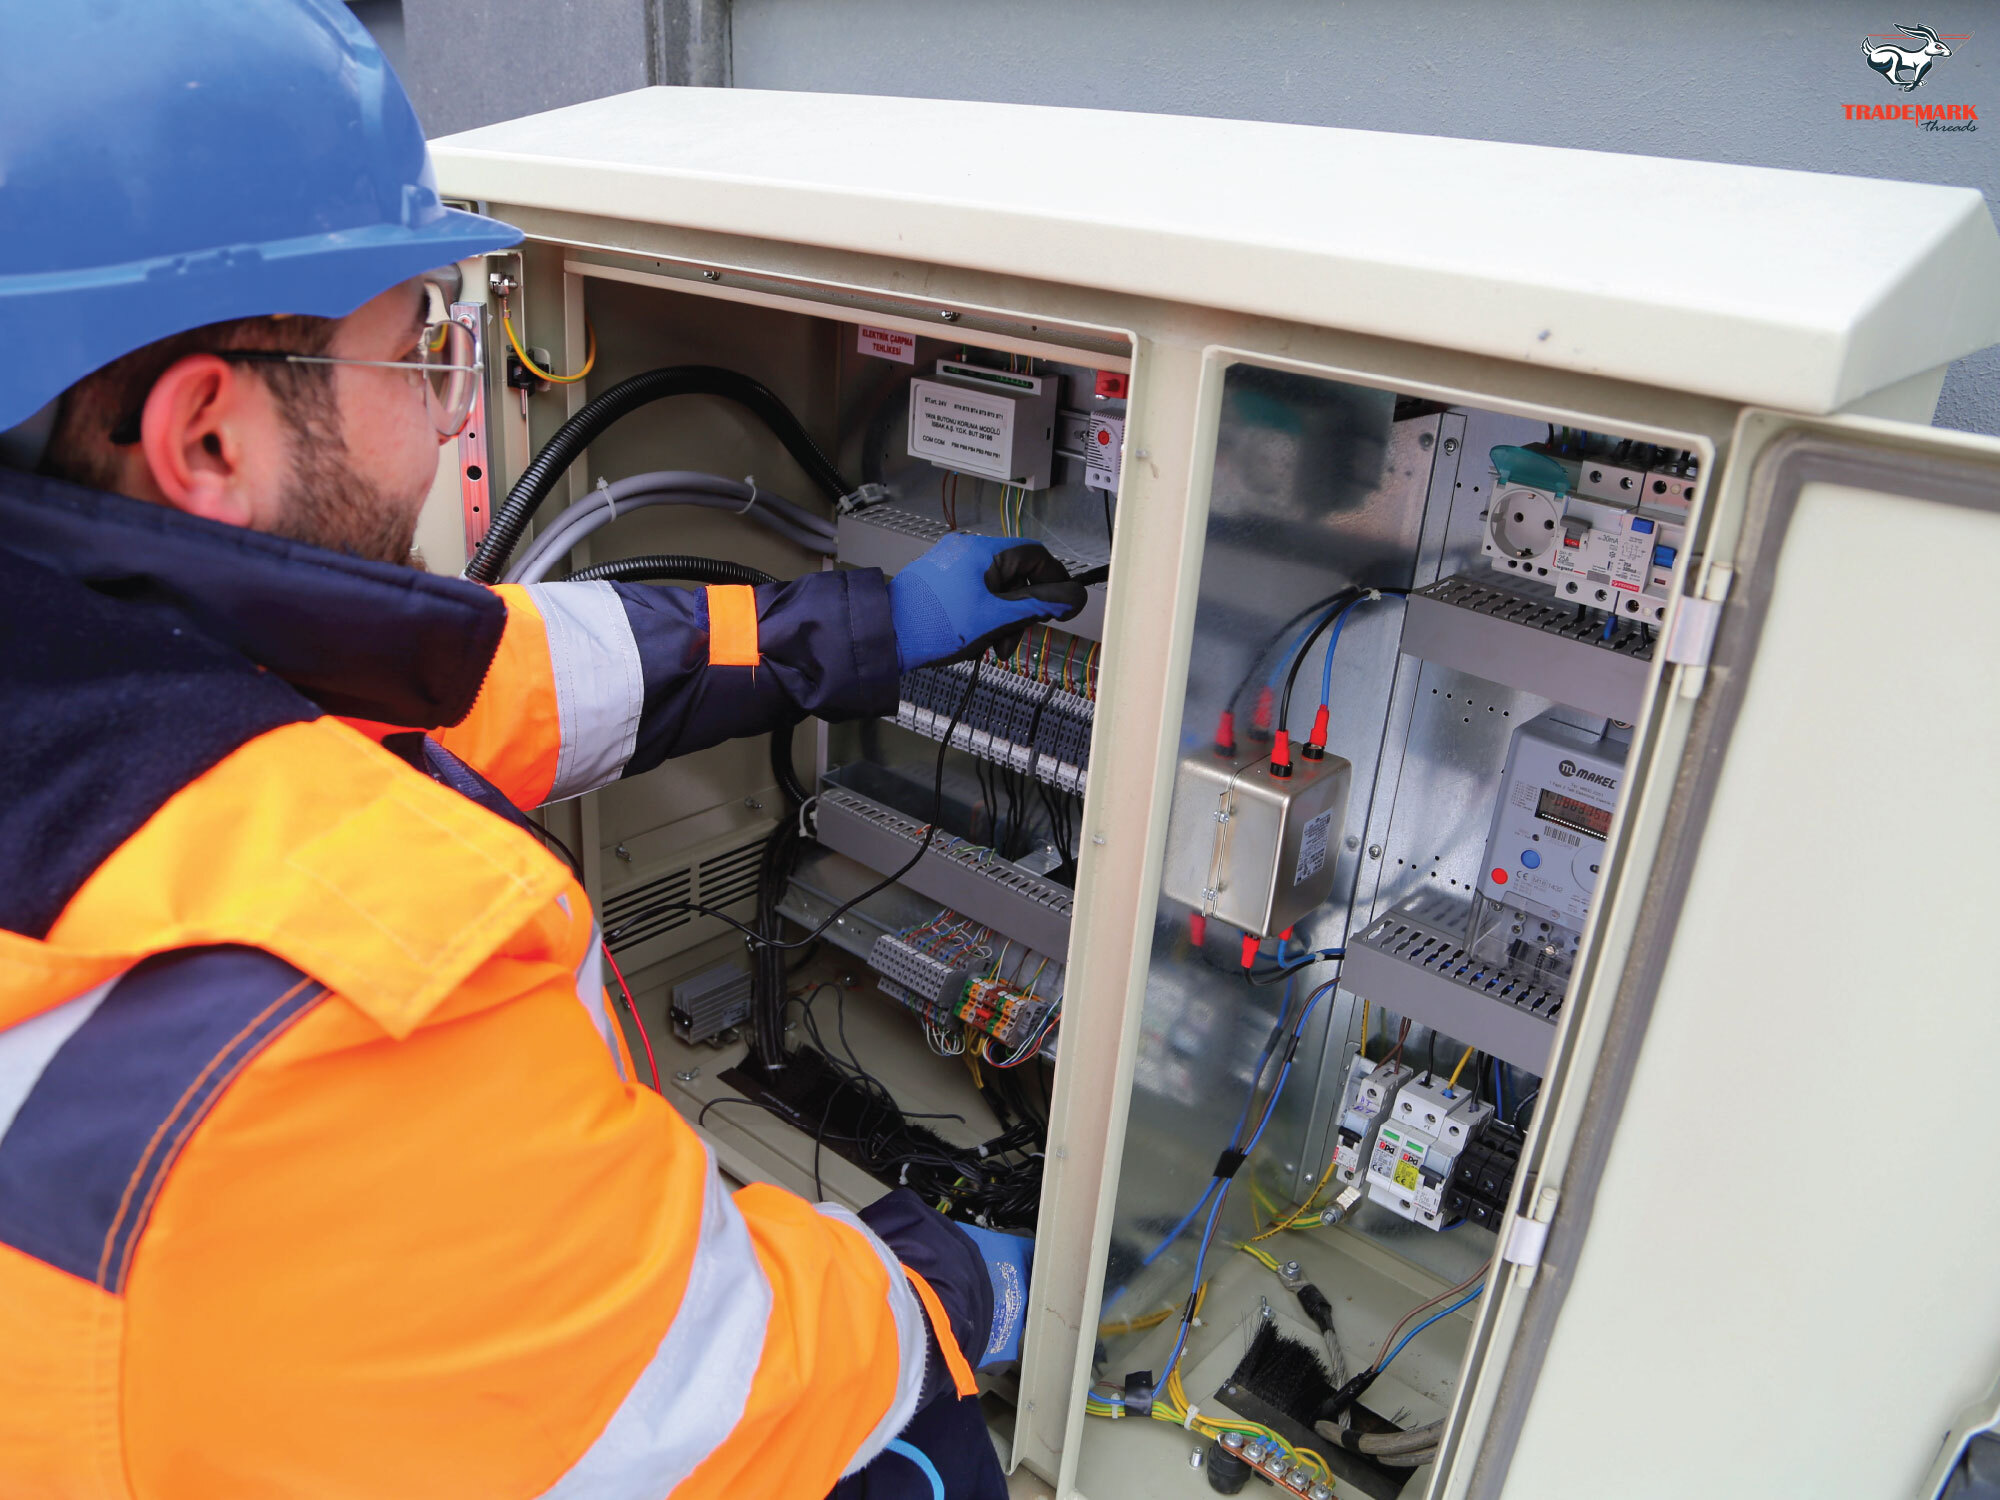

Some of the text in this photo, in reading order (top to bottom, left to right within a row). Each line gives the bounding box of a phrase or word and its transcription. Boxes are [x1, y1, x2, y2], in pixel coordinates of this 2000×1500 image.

[937, 415, 956, 425] BUTONU
[957, 419, 978, 430] KORUMA
[922, 434, 934, 443] COM
[934, 437, 945, 446] COM
[1575, 768, 1618, 790] MAKEL
